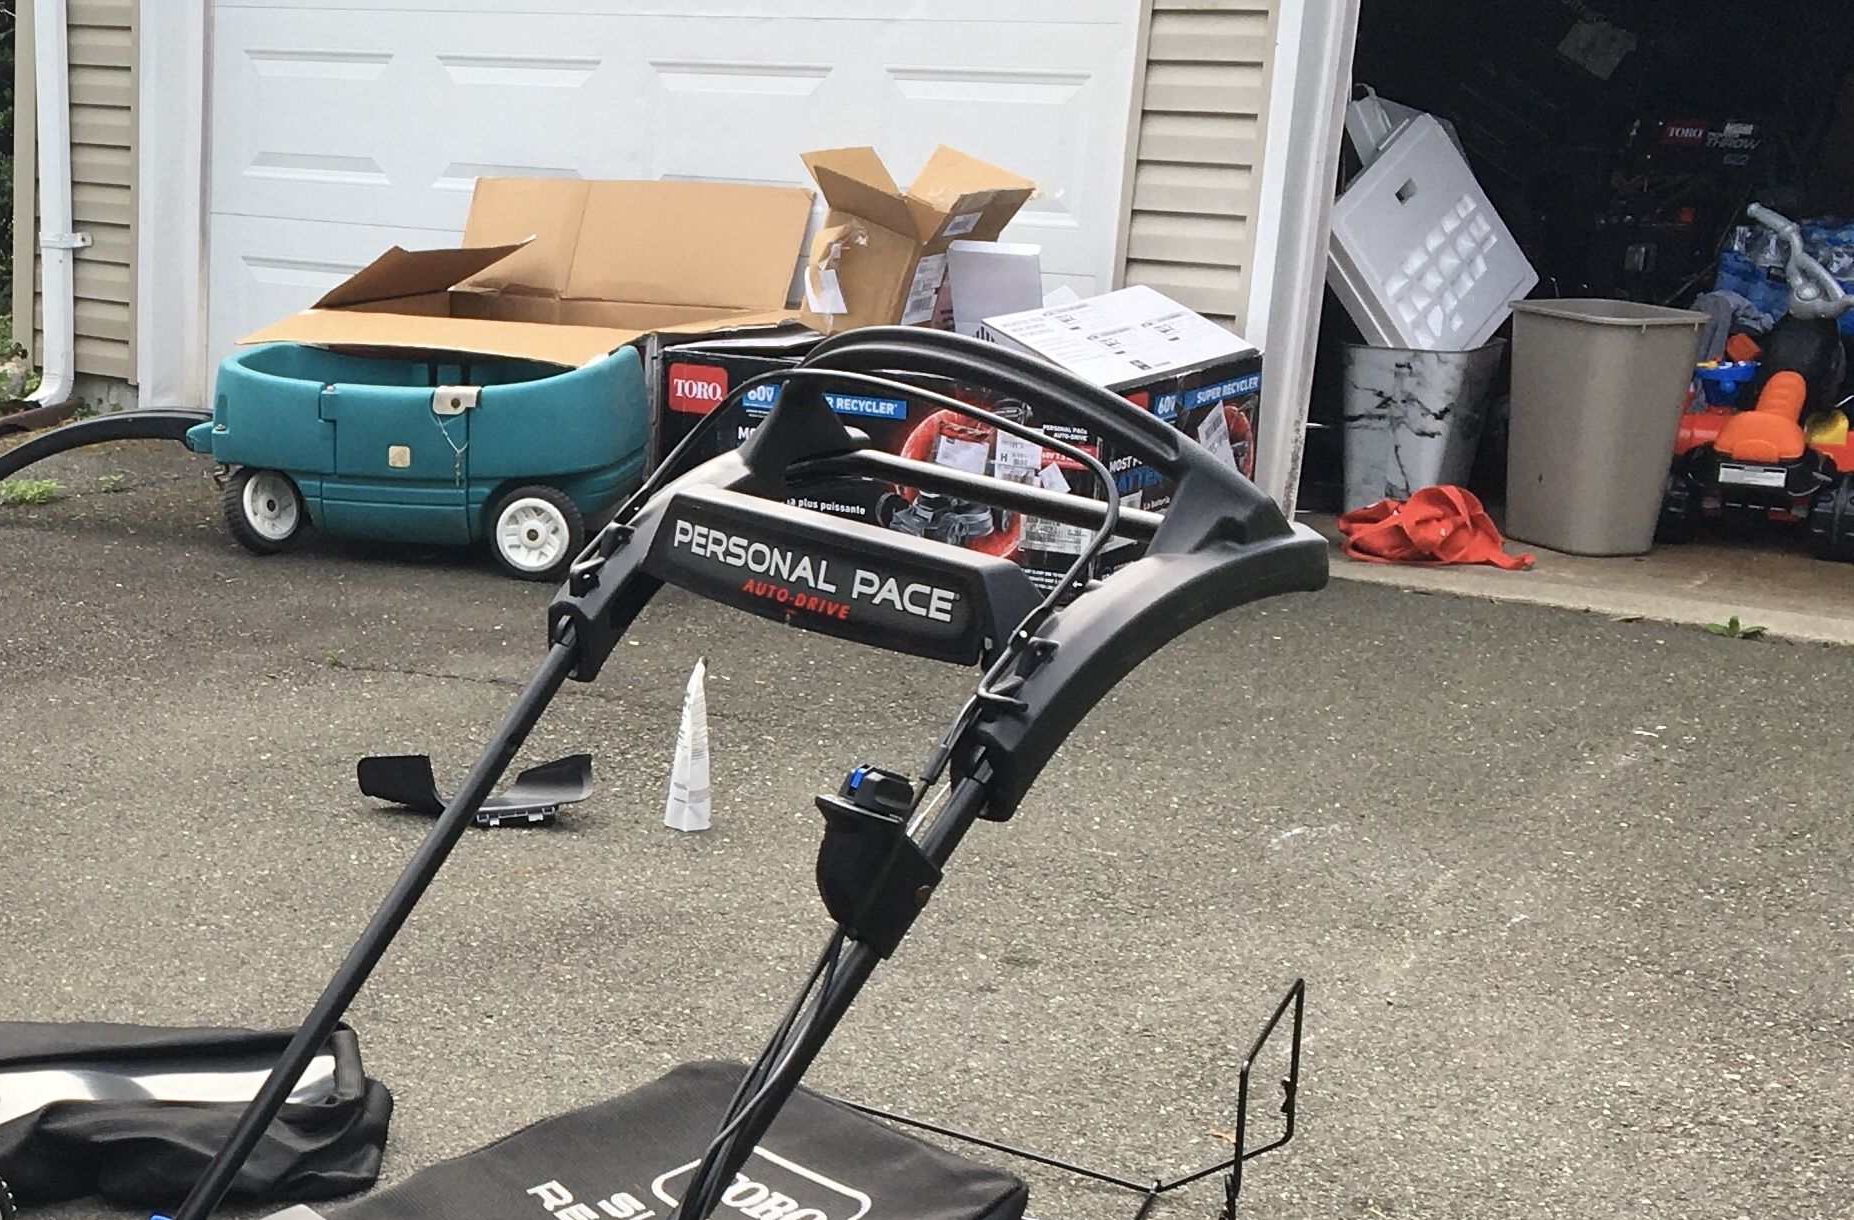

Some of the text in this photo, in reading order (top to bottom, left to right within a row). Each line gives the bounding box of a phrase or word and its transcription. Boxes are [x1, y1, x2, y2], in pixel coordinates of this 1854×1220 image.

[673, 378, 723, 401] TORO
[1196, 377, 1259, 404] SUPER RECYCLER
[836, 399, 895, 415] RECYCLER
[820, 502, 866, 515] puissante
[673, 519, 956, 623] PERSONAL PACE
[743, 578, 850, 620] AUTO-DRIVE
